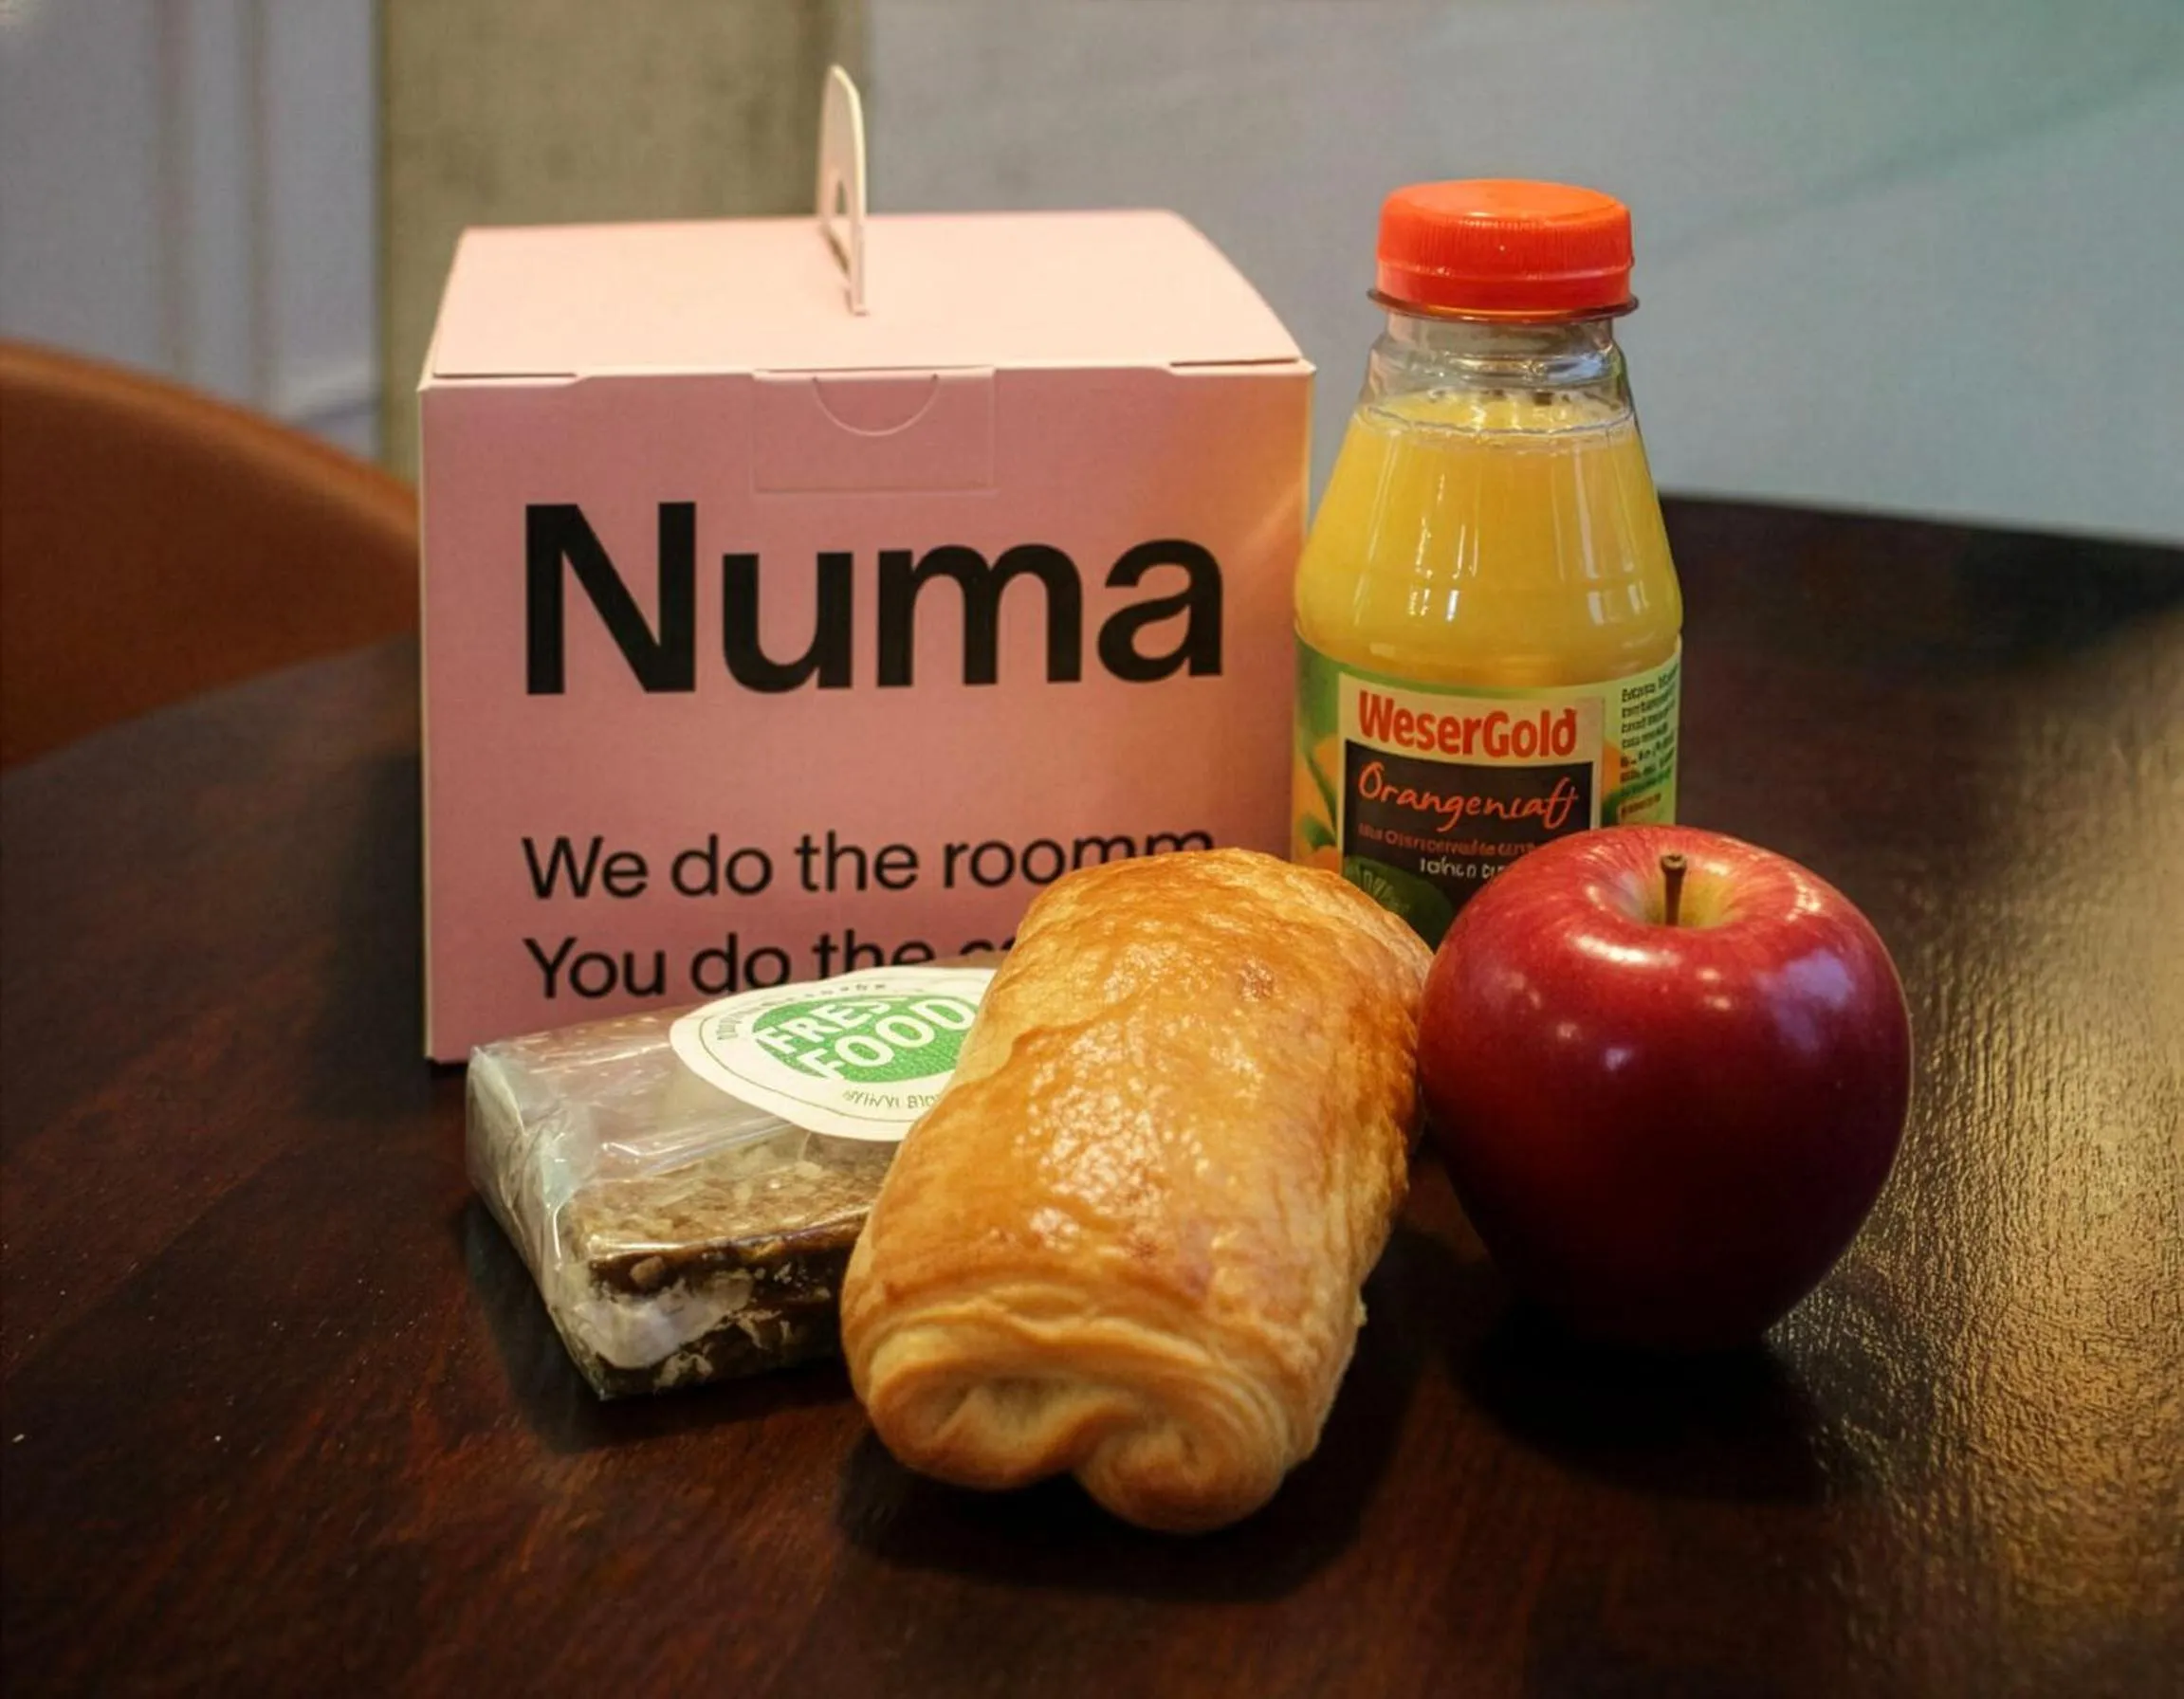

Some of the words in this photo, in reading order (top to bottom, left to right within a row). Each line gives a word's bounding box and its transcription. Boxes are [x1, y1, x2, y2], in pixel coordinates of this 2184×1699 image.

[525, 502, 1223, 695] Numa
[1359, 689, 1577, 758] WeserGold
[522, 835, 649, 900] We
[670, 833, 773, 897] do
[794, 831, 920, 892] the
[523, 937, 667, 1000] You
[689, 932, 791, 996] do
[798, 998, 977, 1081] FOOD
